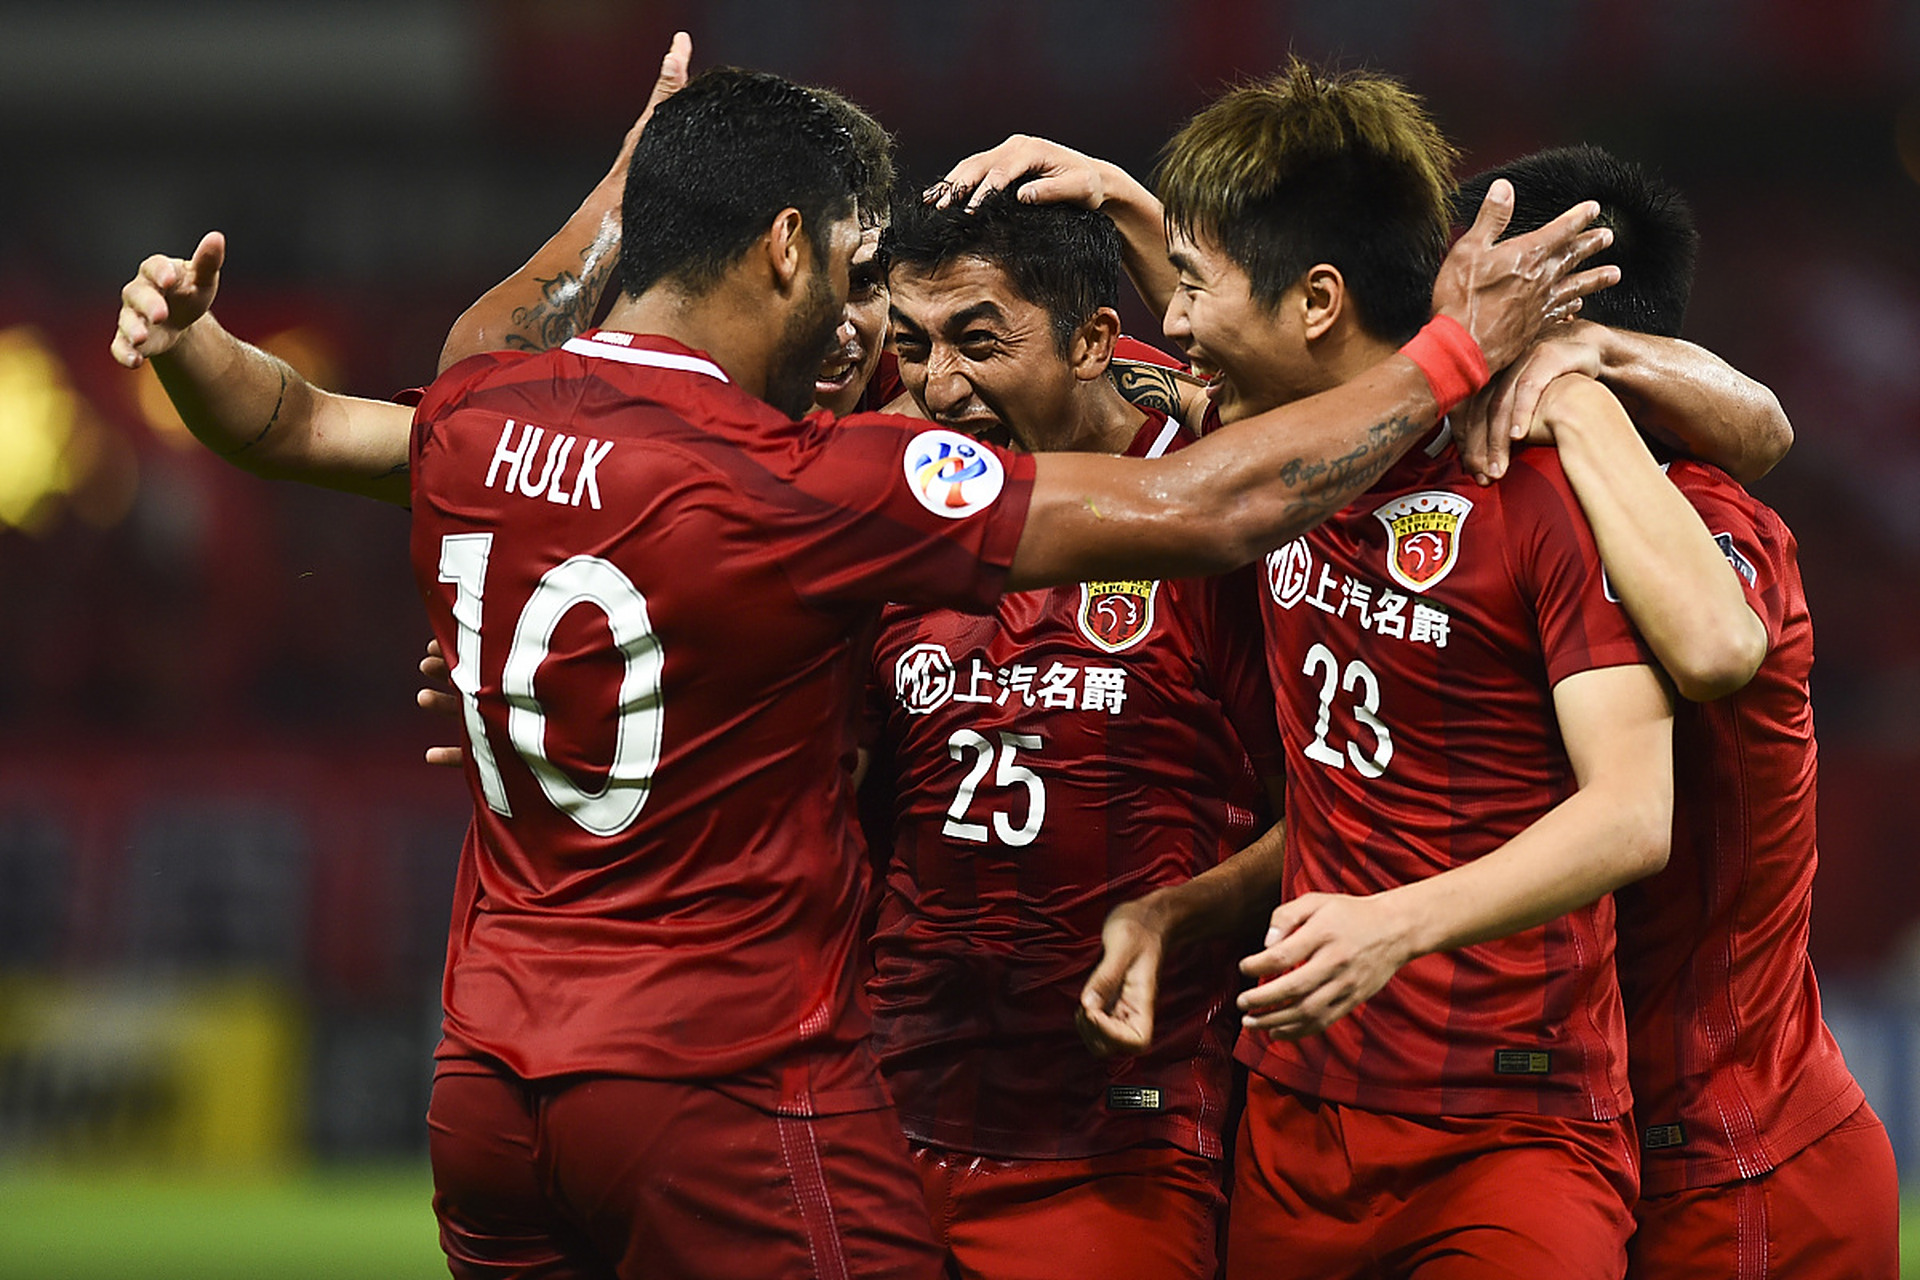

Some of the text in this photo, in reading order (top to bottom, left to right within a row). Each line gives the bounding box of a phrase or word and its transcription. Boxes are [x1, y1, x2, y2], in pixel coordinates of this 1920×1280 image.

[485, 419, 614, 511] HULK
[1267, 538, 1309, 605] MG
[1305, 562, 1451, 649] 上汽名爵
[438, 532, 665, 837] 10
[899, 648, 951, 710] MG
[953, 658, 1128, 714] 上汽名爵
[1302, 643, 1394, 778] 23
[942, 728, 1046, 847] 25
